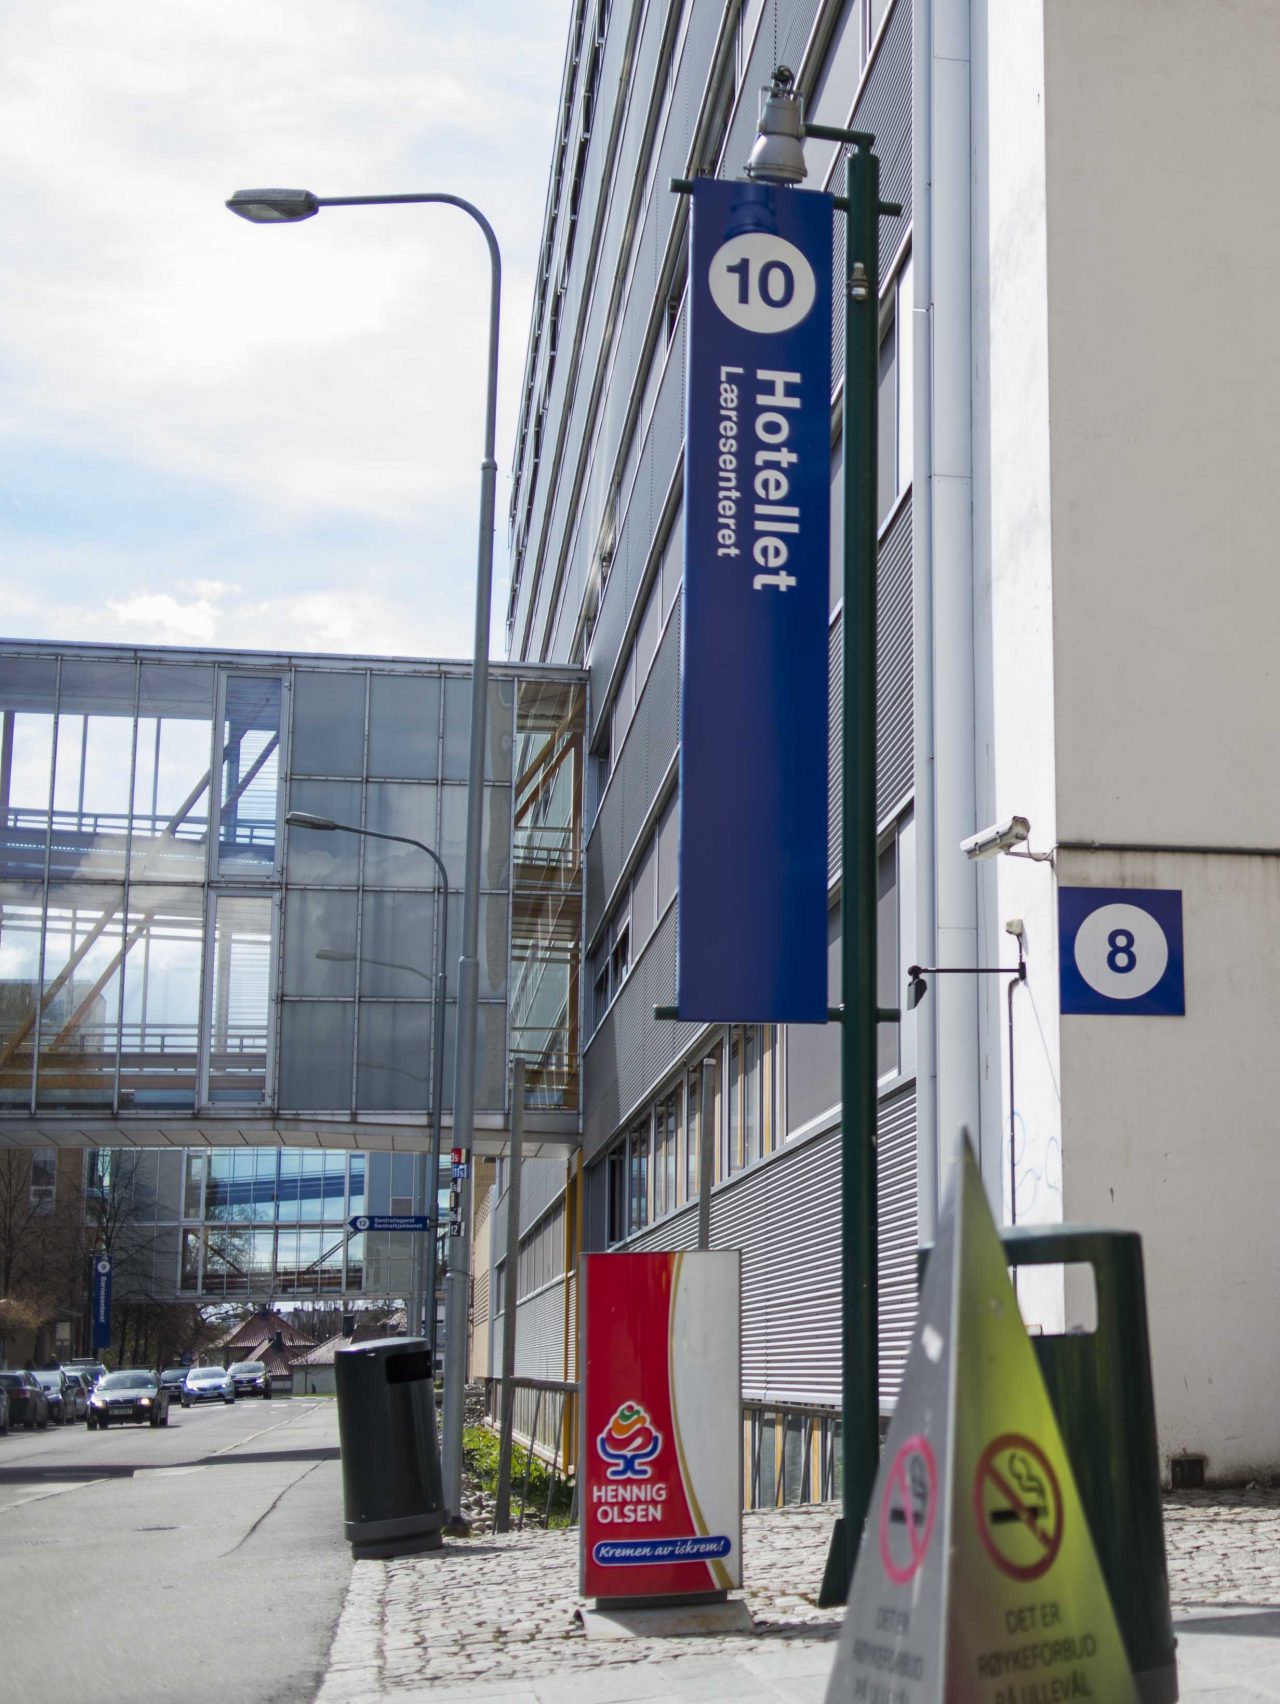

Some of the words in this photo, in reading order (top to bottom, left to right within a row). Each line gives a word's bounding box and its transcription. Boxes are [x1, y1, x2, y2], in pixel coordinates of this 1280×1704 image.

[726, 257, 794, 309] 10
[716, 366, 745, 558] Læresenteret
[752, 369, 802, 592] Hotellet
[1106, 928, 1137, 974] 8
[592, 1484, 667, 1503] HENNIG
[596, 1504, 662, 1524] OLSEN
[598, 1545, 652, 1559] Kremen
[654, 1546, 674, 1556] av
[674, 1540, 725, 1555] iskrem!
[1005, 1605, 1037, 1635] DET
[1040, 1601, 1063, 1629] ER
